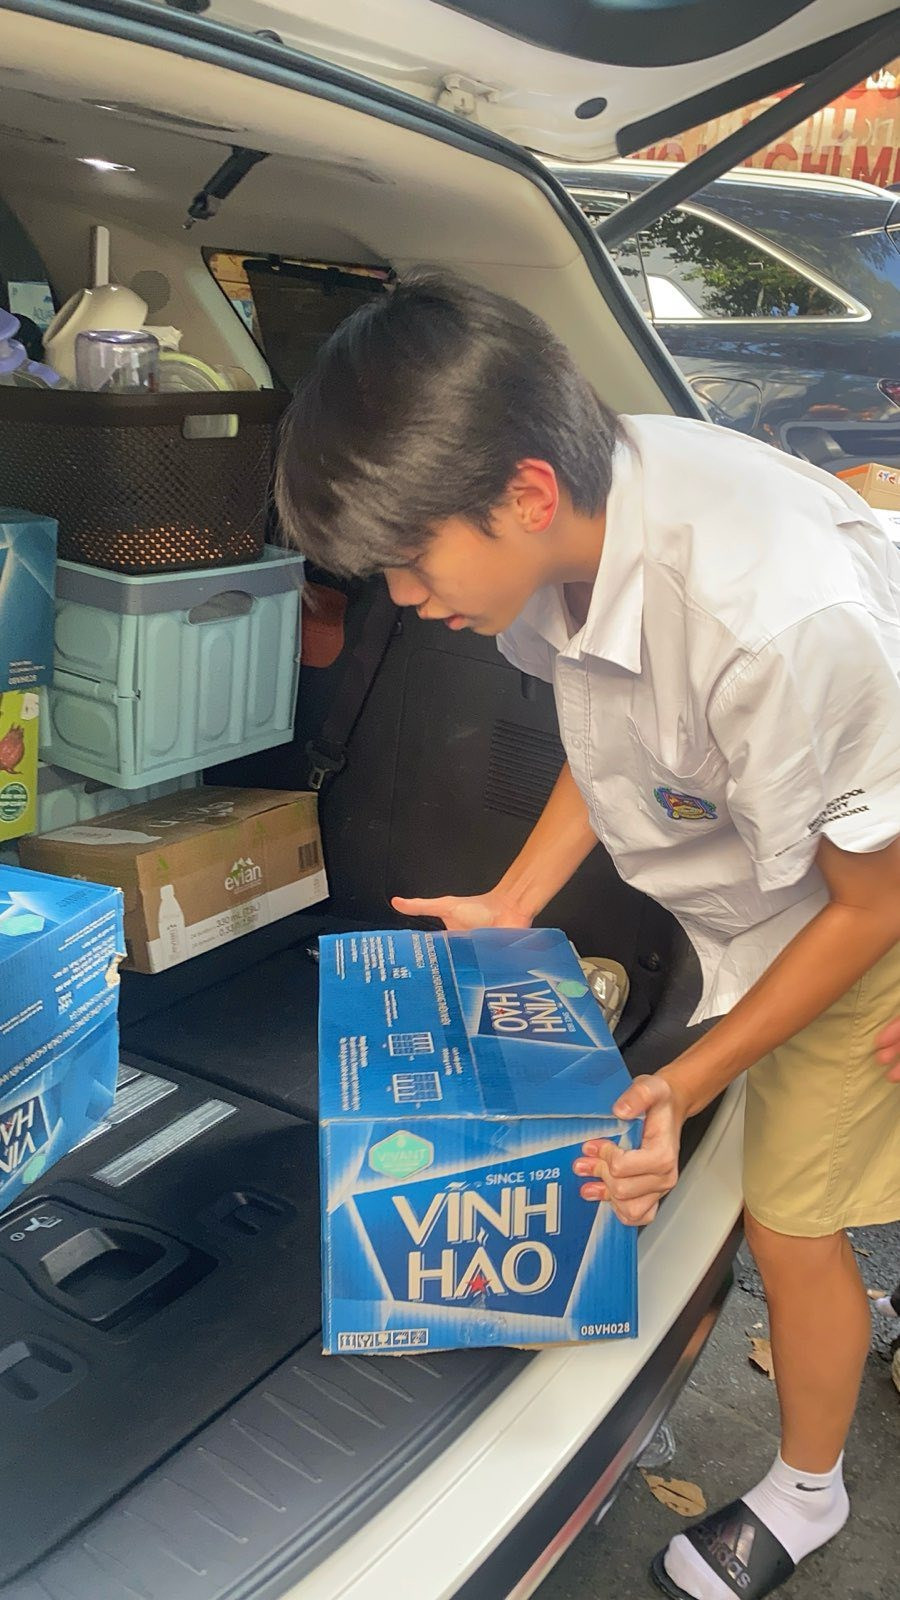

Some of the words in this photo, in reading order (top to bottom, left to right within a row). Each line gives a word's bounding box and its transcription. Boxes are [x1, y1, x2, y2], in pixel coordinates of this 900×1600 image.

[224, 864, 263, 891] evian
[485, 1171, 525, 1186] SINCE
[529, 1167, 561, 1182] 1928
[392, 1182, 562, 1248] VĨNH
[581, 1321, 630, 1336] 08VH028
